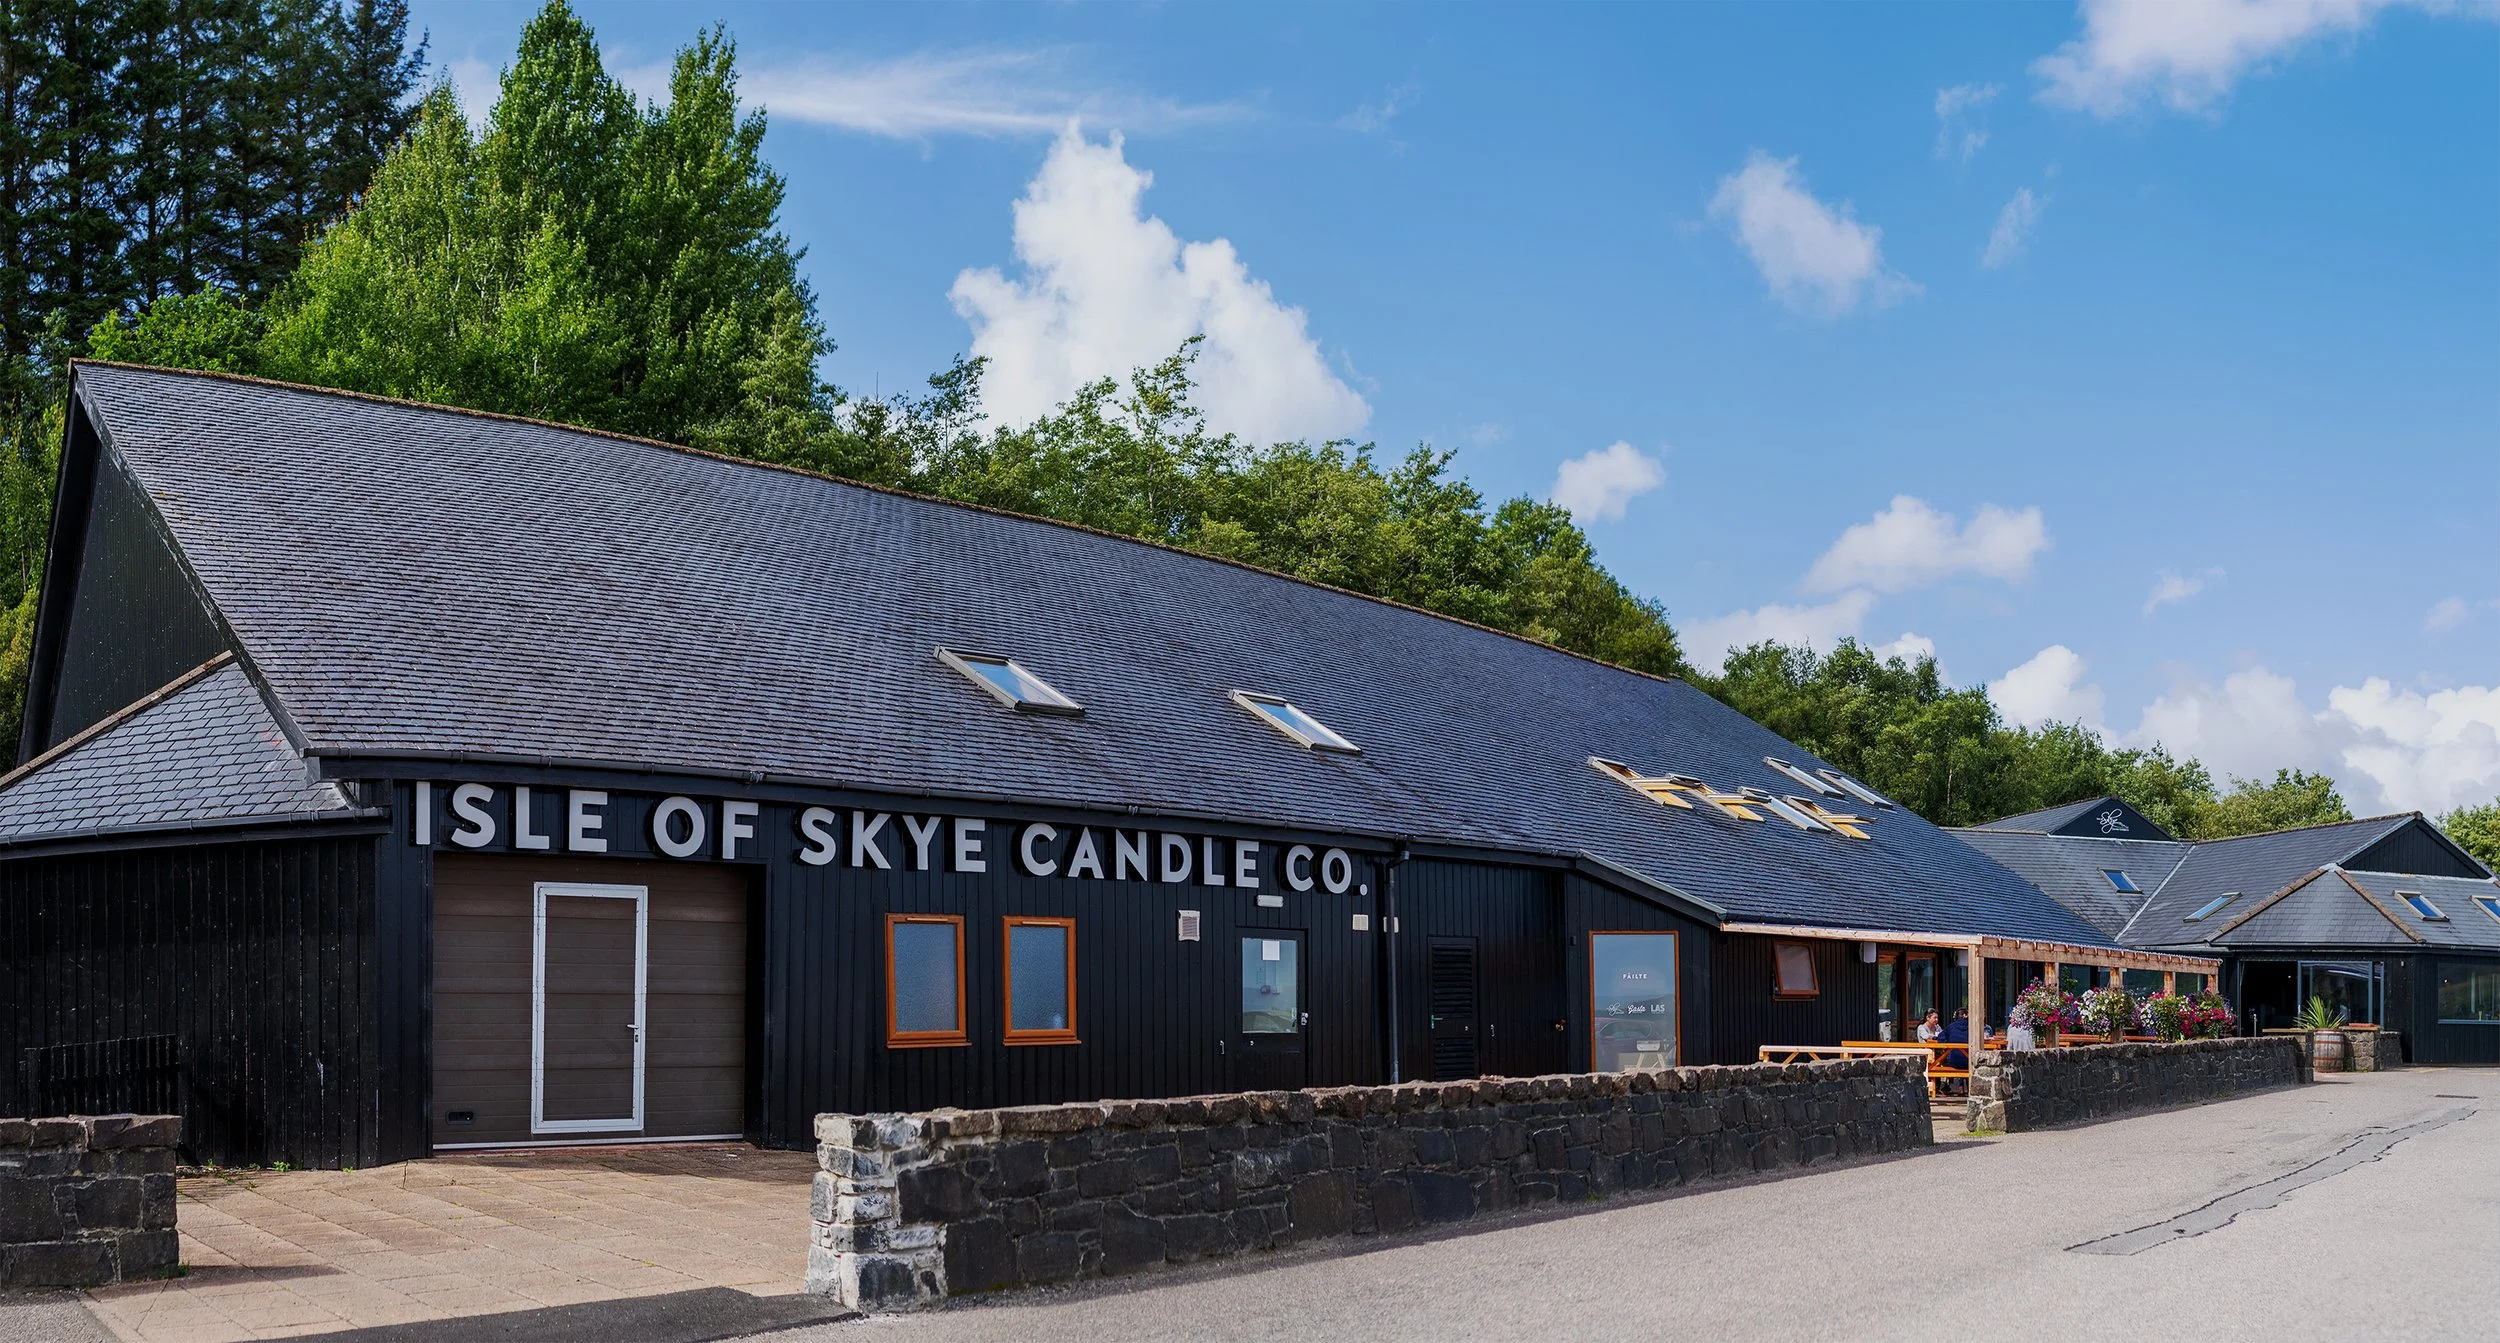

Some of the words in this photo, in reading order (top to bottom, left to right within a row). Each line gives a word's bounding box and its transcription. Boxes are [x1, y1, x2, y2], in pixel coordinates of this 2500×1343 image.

[415, 780, 608, 853] ISLE
[653, 796, 760, 860] OF
[799, 806, 987, 873] SKYE
[1020, 822, 1260, 889] CANDLE
[1285, 844, 1368, 897] CO.
